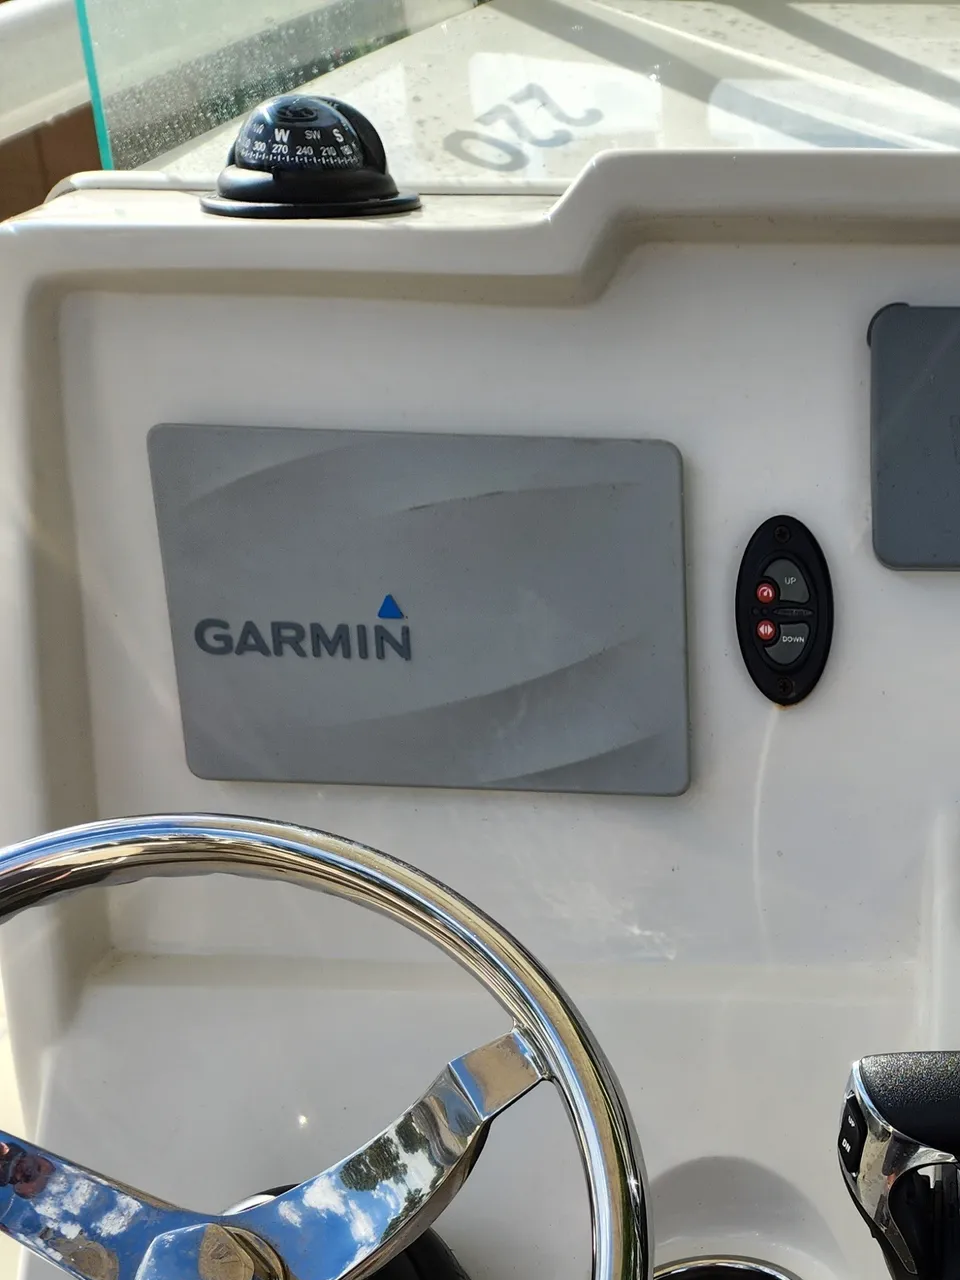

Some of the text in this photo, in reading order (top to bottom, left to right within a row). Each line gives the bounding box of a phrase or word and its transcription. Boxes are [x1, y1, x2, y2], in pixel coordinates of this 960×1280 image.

[274, 128, 291, 143] W
[304, 129, 321, 140] SW
[332, 129, 345, 143] S
[252, 140, 266, 152] 300
[272, 144, 289, 154] 270
[296, 145, 314, 156] 240
[320, 146, 337, 156] 210
[784, 576, 797, 585] UP
[194, 617, 412, 661] GARMIN
[782, 635, 805, 643] DOWN
